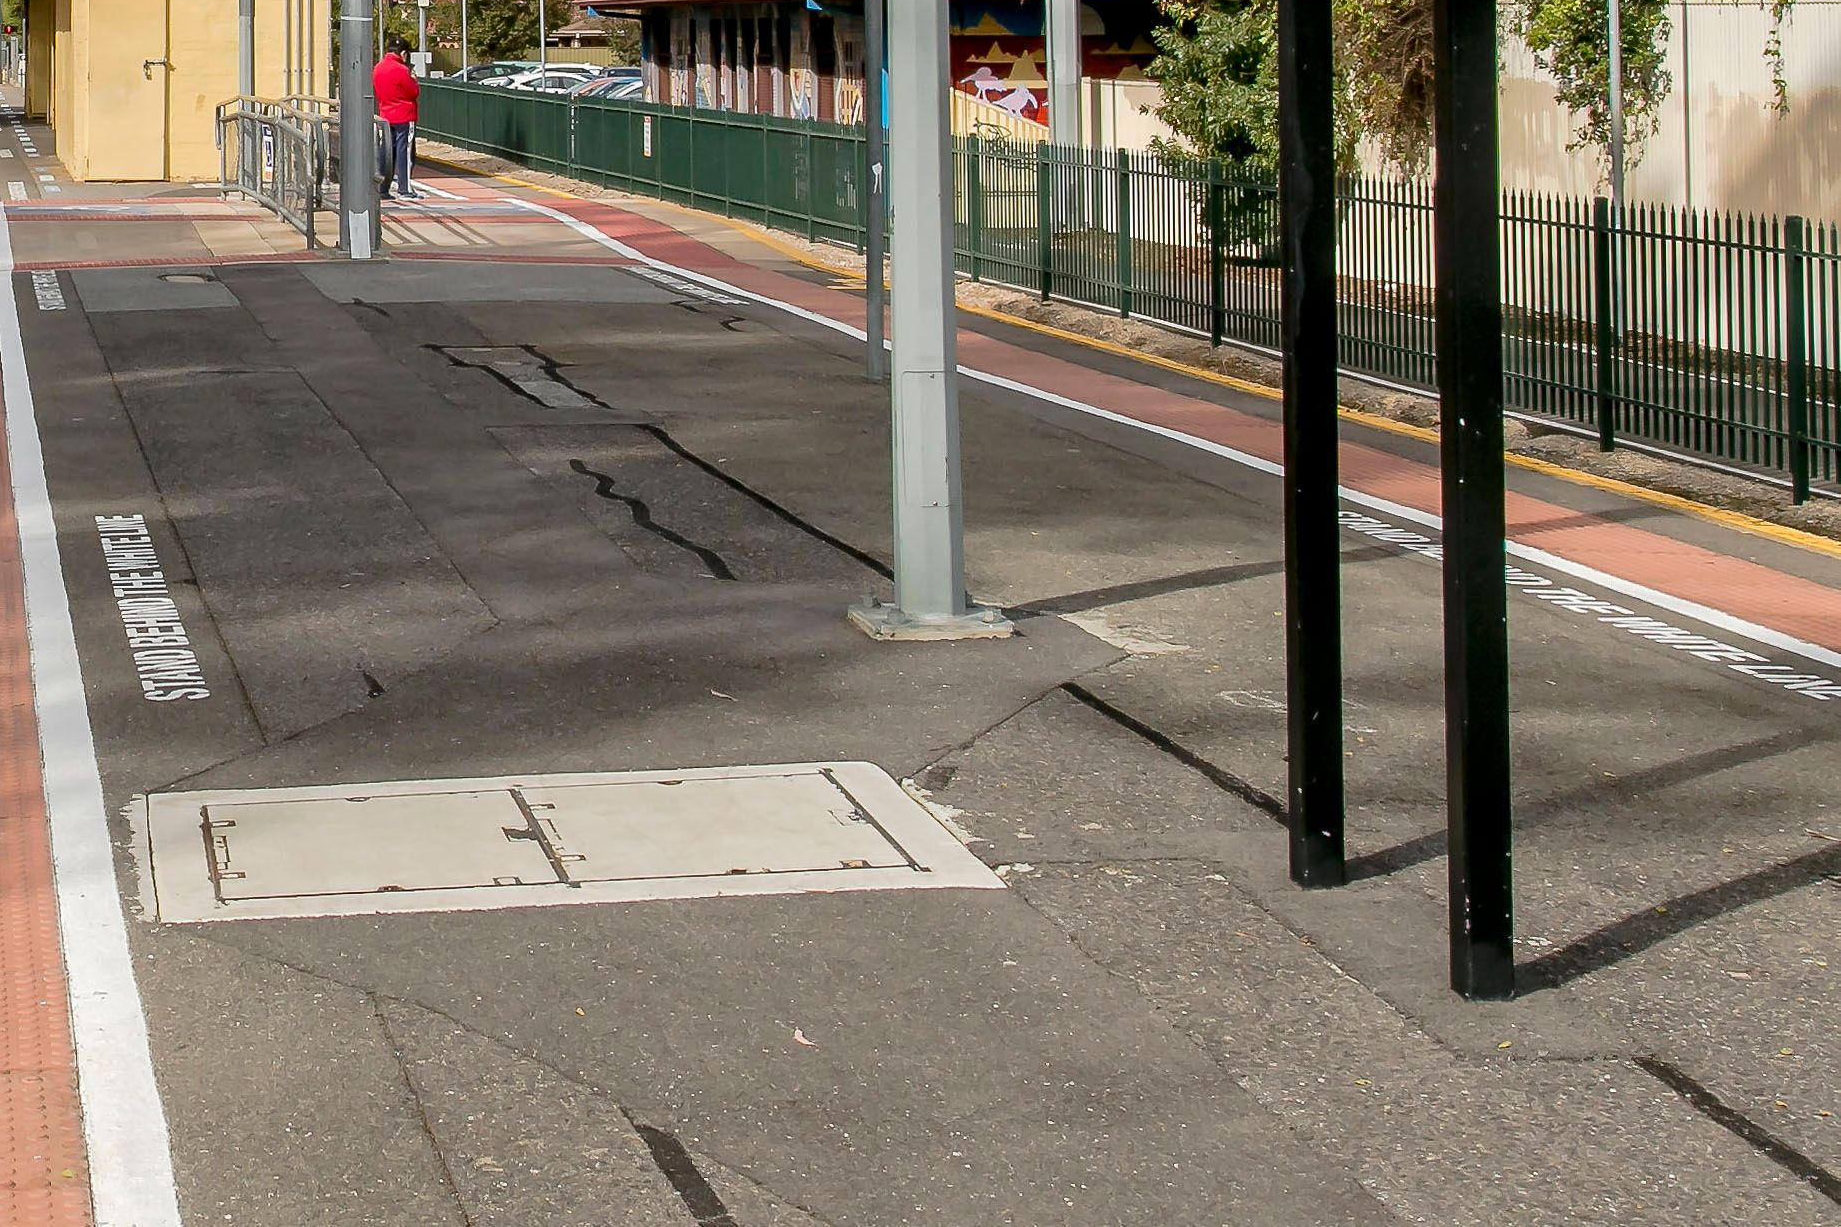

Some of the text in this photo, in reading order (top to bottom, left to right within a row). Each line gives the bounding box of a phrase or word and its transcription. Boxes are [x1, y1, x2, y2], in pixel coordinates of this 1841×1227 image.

[95, 514, 211, 702] STAND BEHIND THE WHITE LINE
[1522, 587, 1635, 615] THE
[1597, 616, 1771, 662] WHITE
